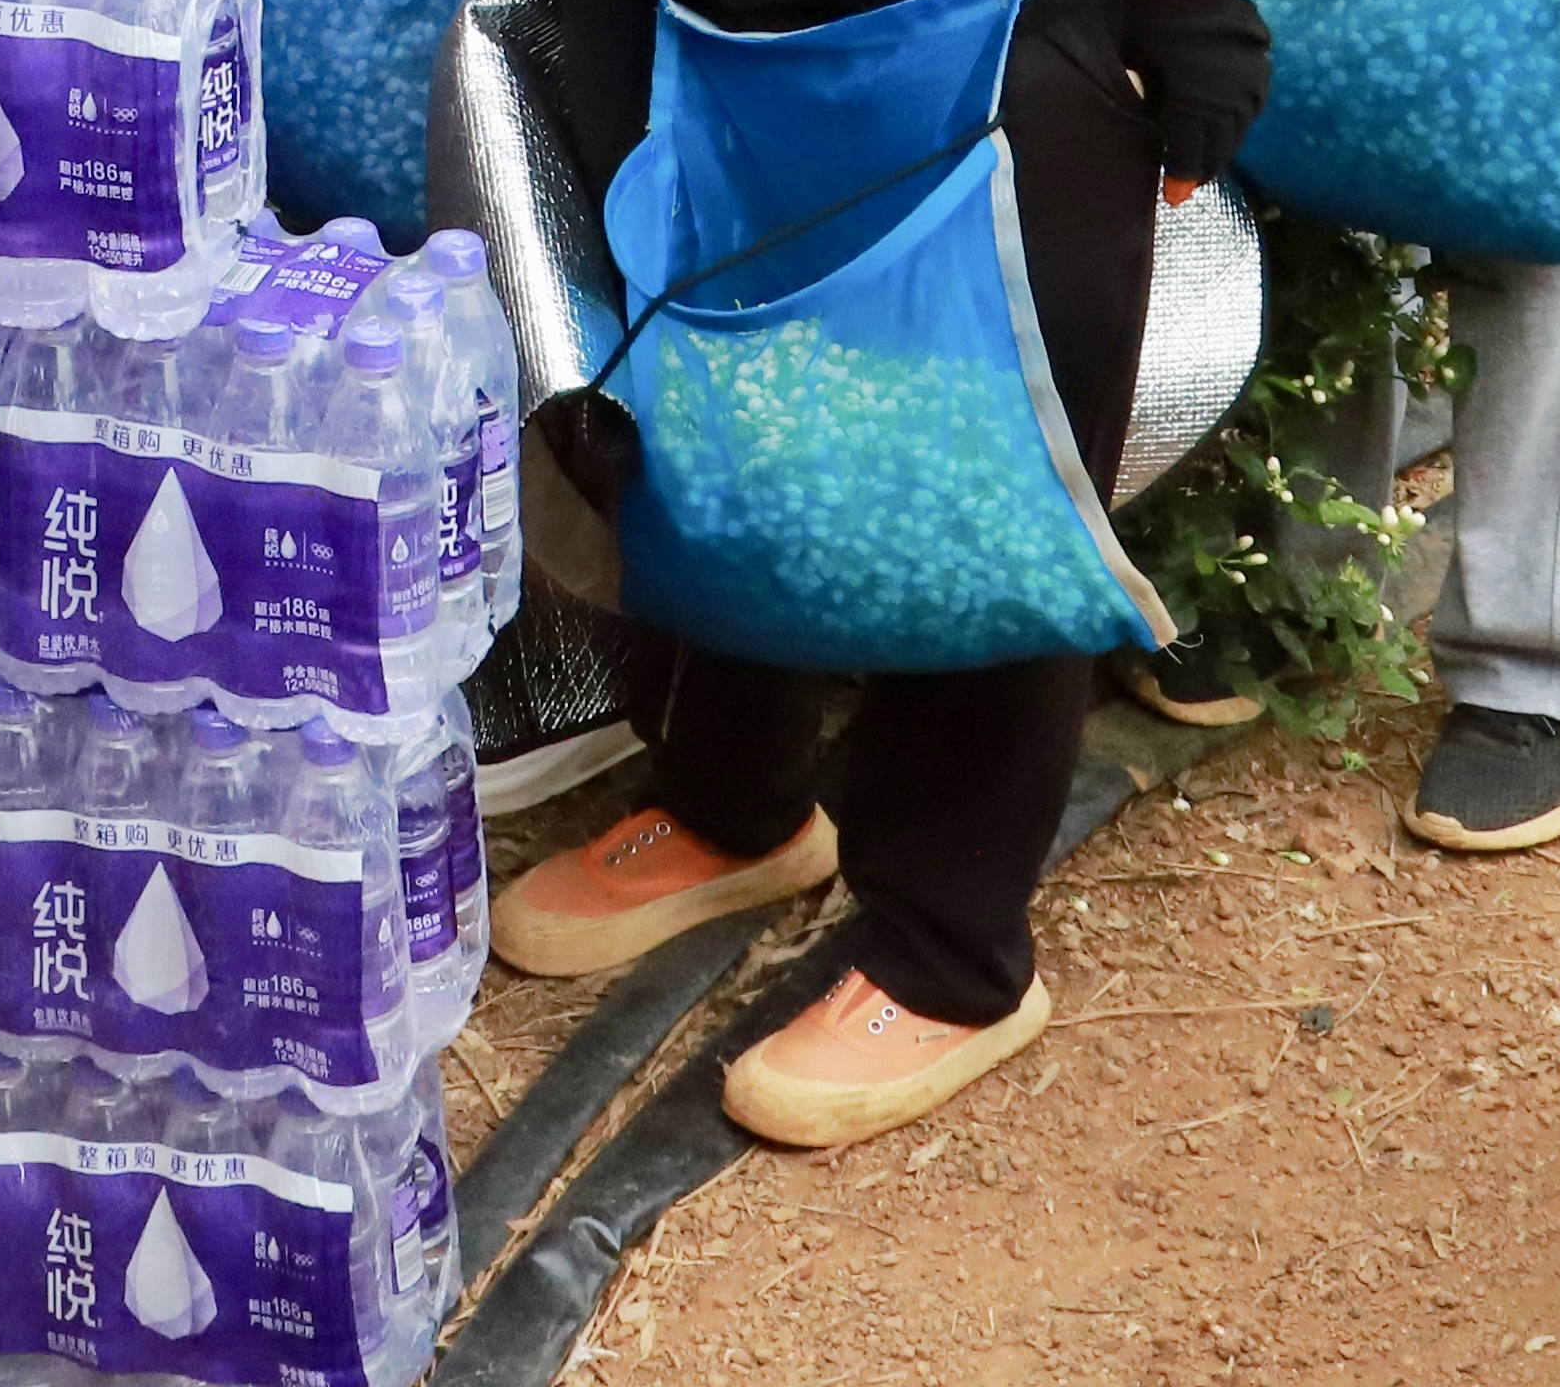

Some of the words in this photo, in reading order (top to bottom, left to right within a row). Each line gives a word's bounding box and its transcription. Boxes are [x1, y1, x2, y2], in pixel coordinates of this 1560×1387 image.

[201, 60, 234, 152] 纯悦
[93, 418, 161, 454] 整箱购
[182, 436, 254, 477] 更优惠
[40, 486, 99, 621] 纯悦
[167, 831, 239, 862] 更优惠
[32, 880, 90, 1001] 纯悦
[78, 1143, 156, 1173] 整箱购
[170, 1155, 248, 1182] 更优惠
[46, 1208, 96, 1328] 纯悦
